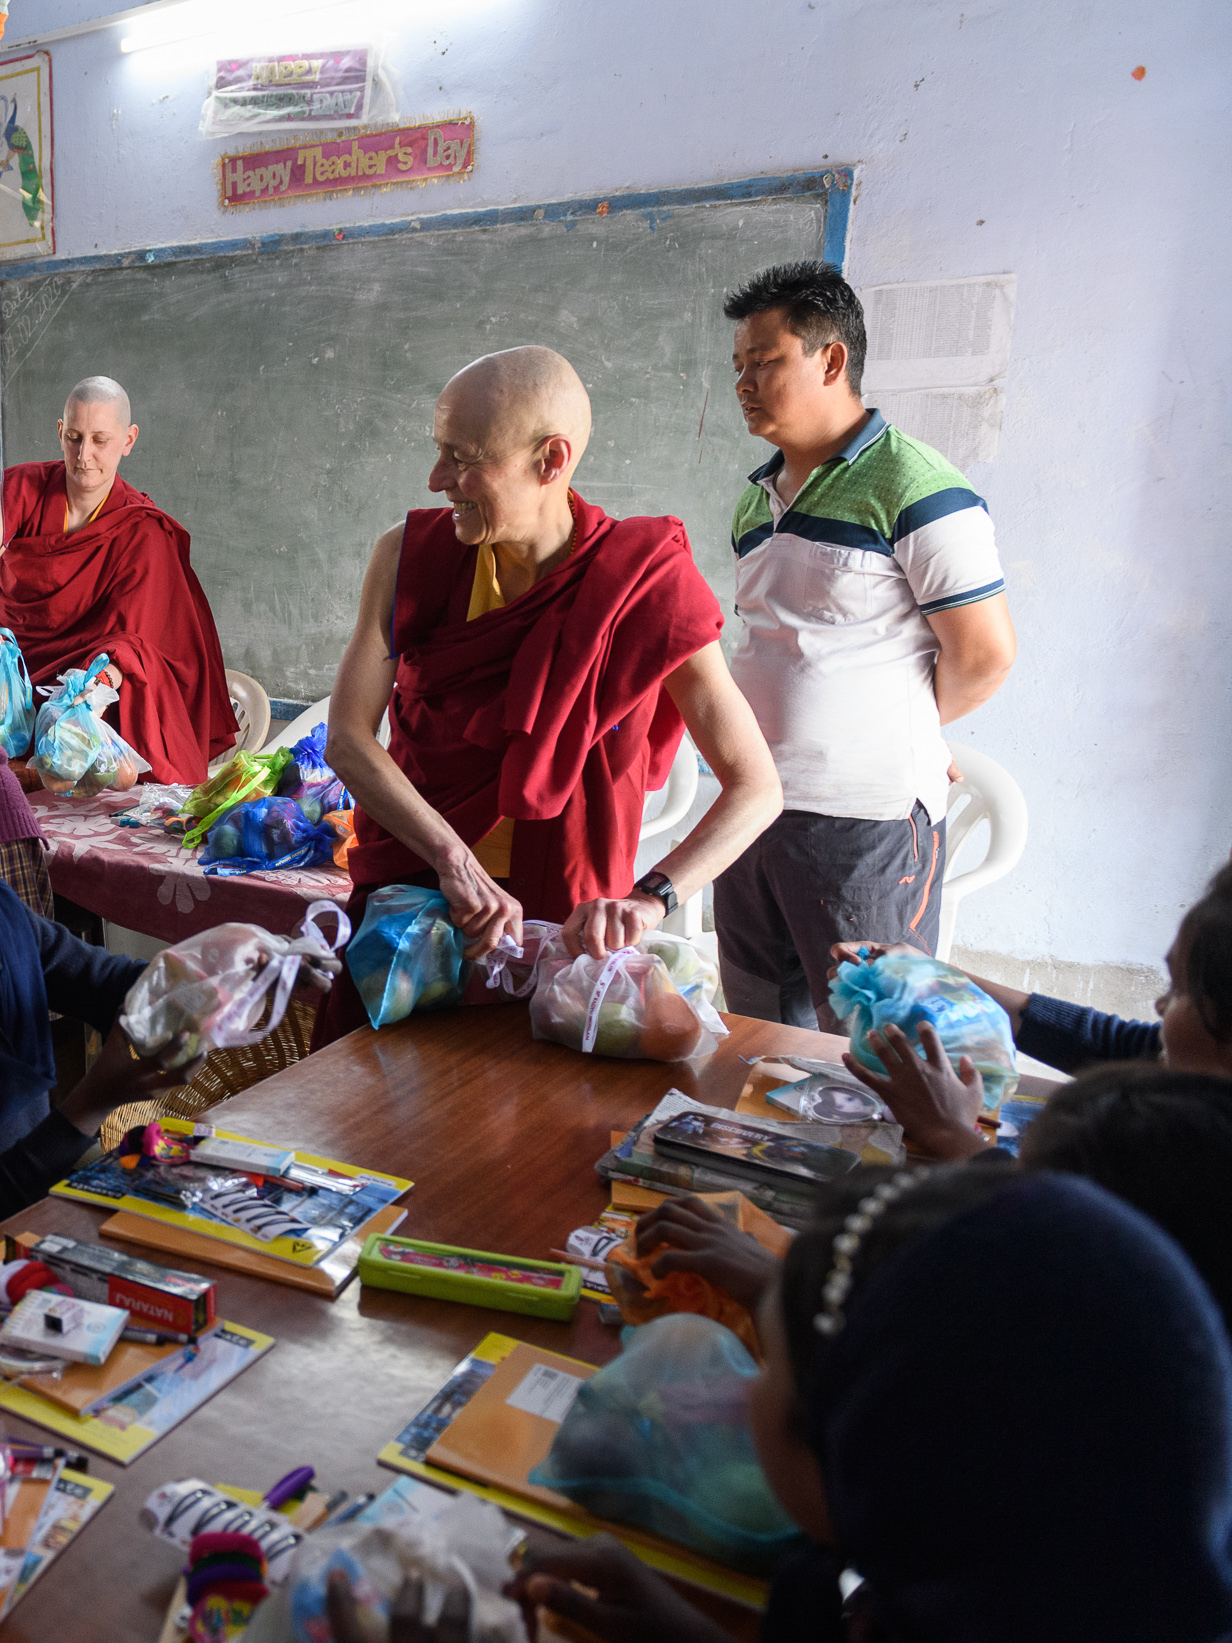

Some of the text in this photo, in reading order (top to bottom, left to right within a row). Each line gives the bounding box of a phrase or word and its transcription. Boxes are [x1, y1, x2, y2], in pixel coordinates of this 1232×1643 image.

[251, 59, 323, 85] HAPPY
[311, 91, 361, 116] DAY
[225, 128, 471, 197] Happy Teacher's Day
[2, 286, 34, 320] Date
[585, 1015, 593, 1041] MONLAM
[710, 1122, 772, 1141] DISCOVERY
[116, 1293, 173, 1323] NATARAJ
